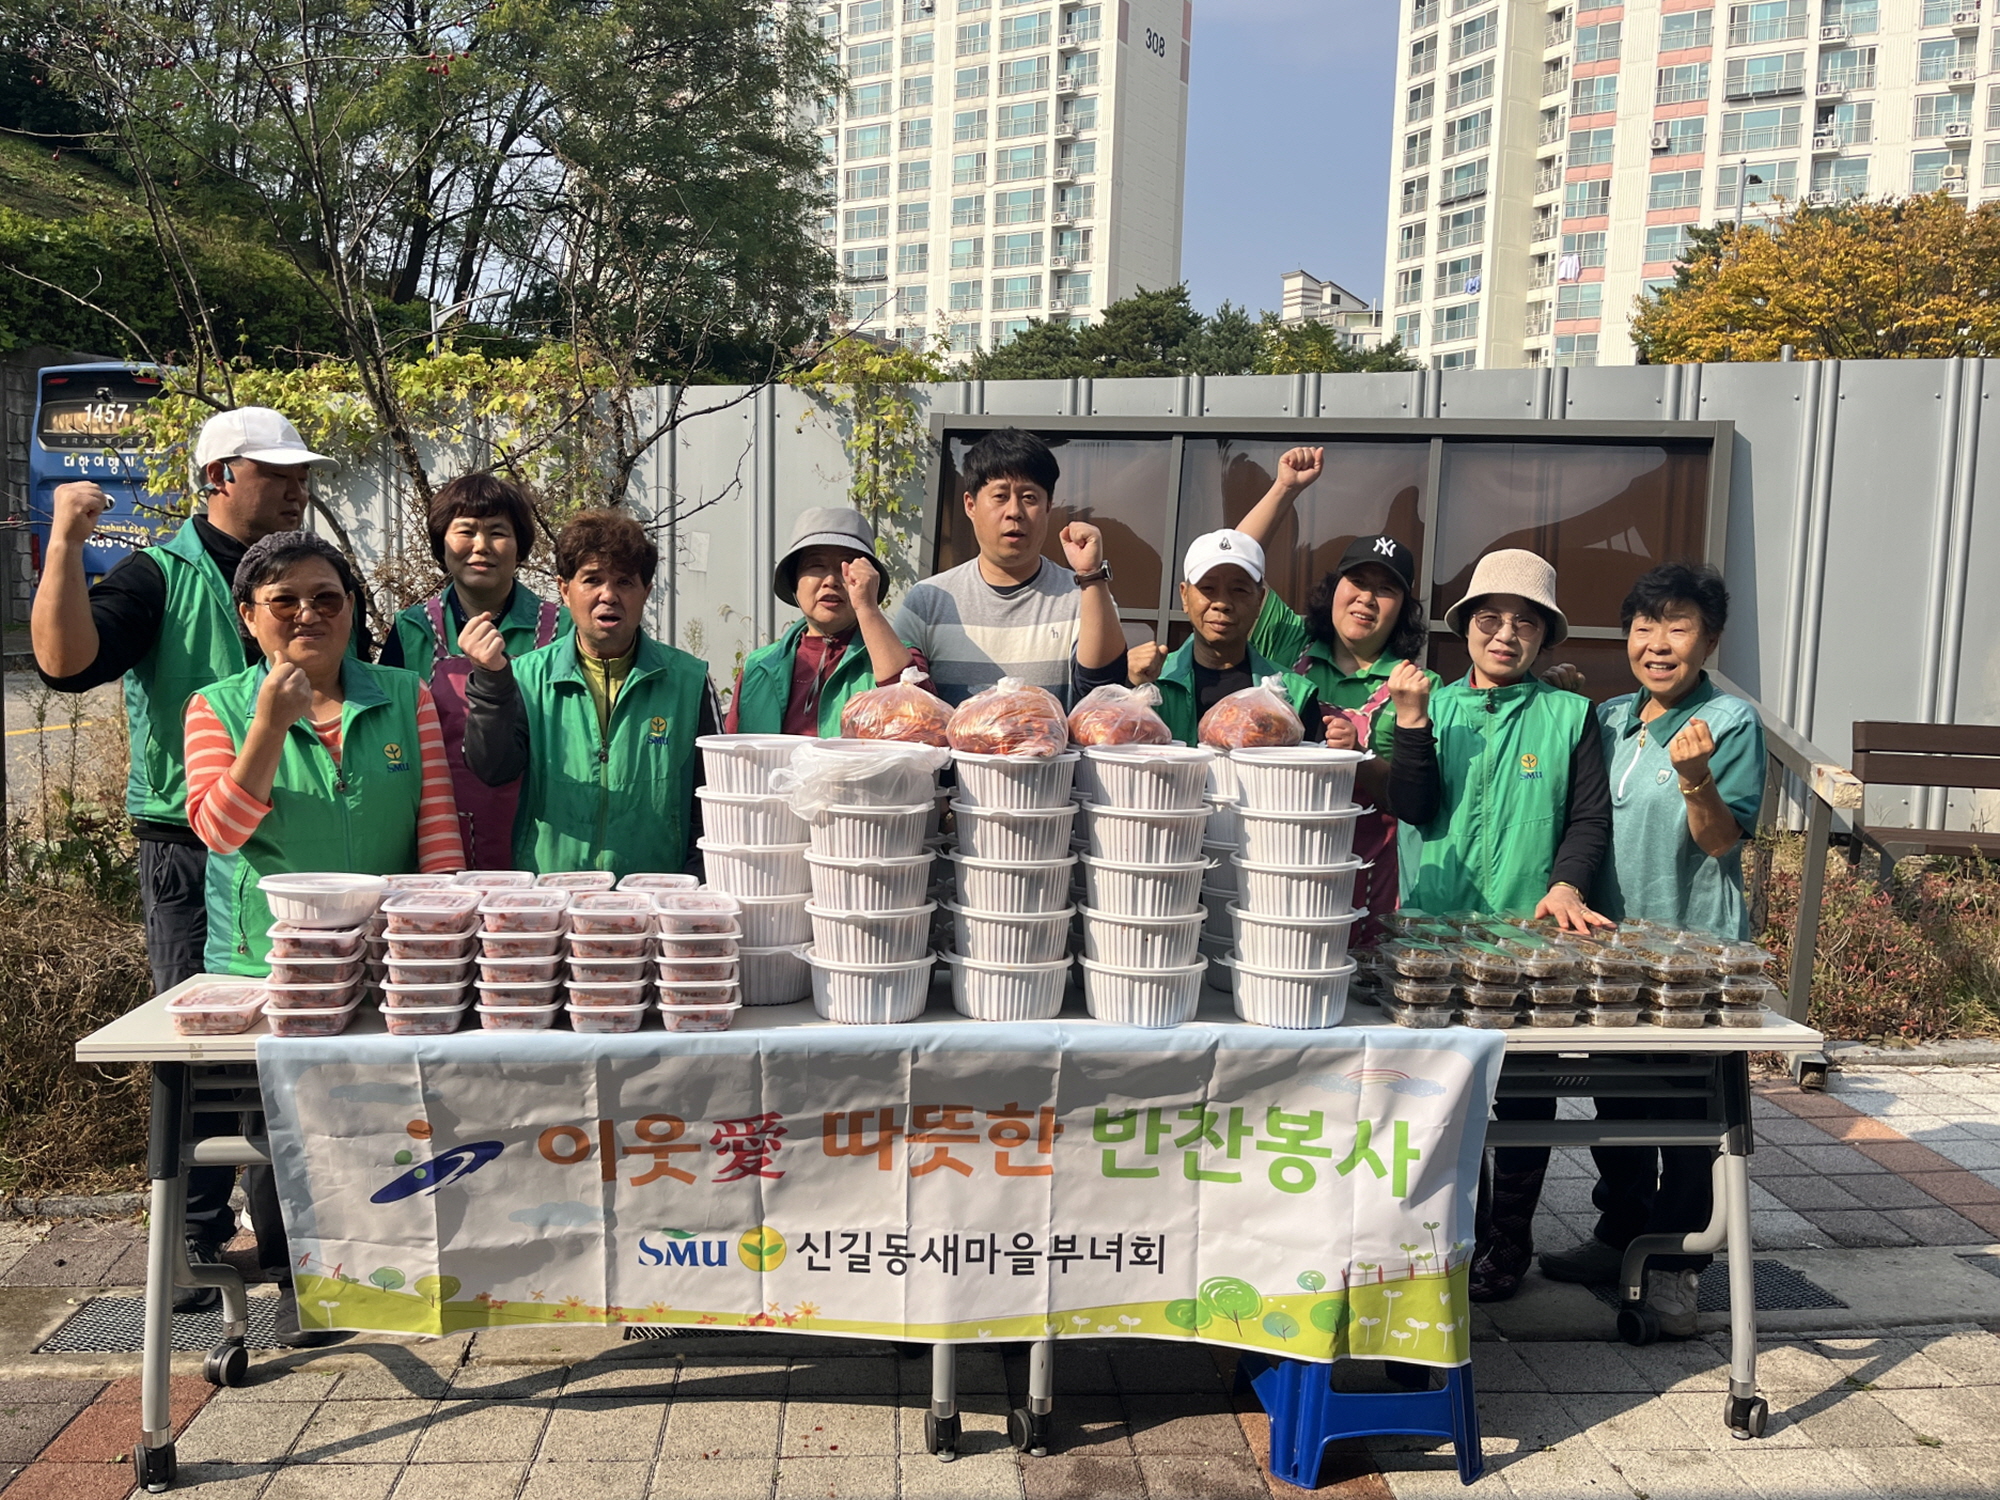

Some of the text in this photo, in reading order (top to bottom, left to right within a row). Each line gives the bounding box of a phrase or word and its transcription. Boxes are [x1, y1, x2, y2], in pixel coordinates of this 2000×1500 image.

[1145, 27, 1166, 58] 308
[84, 403, 129, 424] 1457
[1373, 536, 1397, 558] NY
[647, 735, 669, 746] SMU
[386, 762, 410, 774] SMU
[1519, 771, 1543, 781] SMU
[822, 1102, 1064, 1178] 따뜻한
[1092, 1101, 1421, 1198] 반찬봉사
[638, 1236, 729, 1267] SMU
[796, 1230, 1166, 1276] 신길동새마을부녀회
